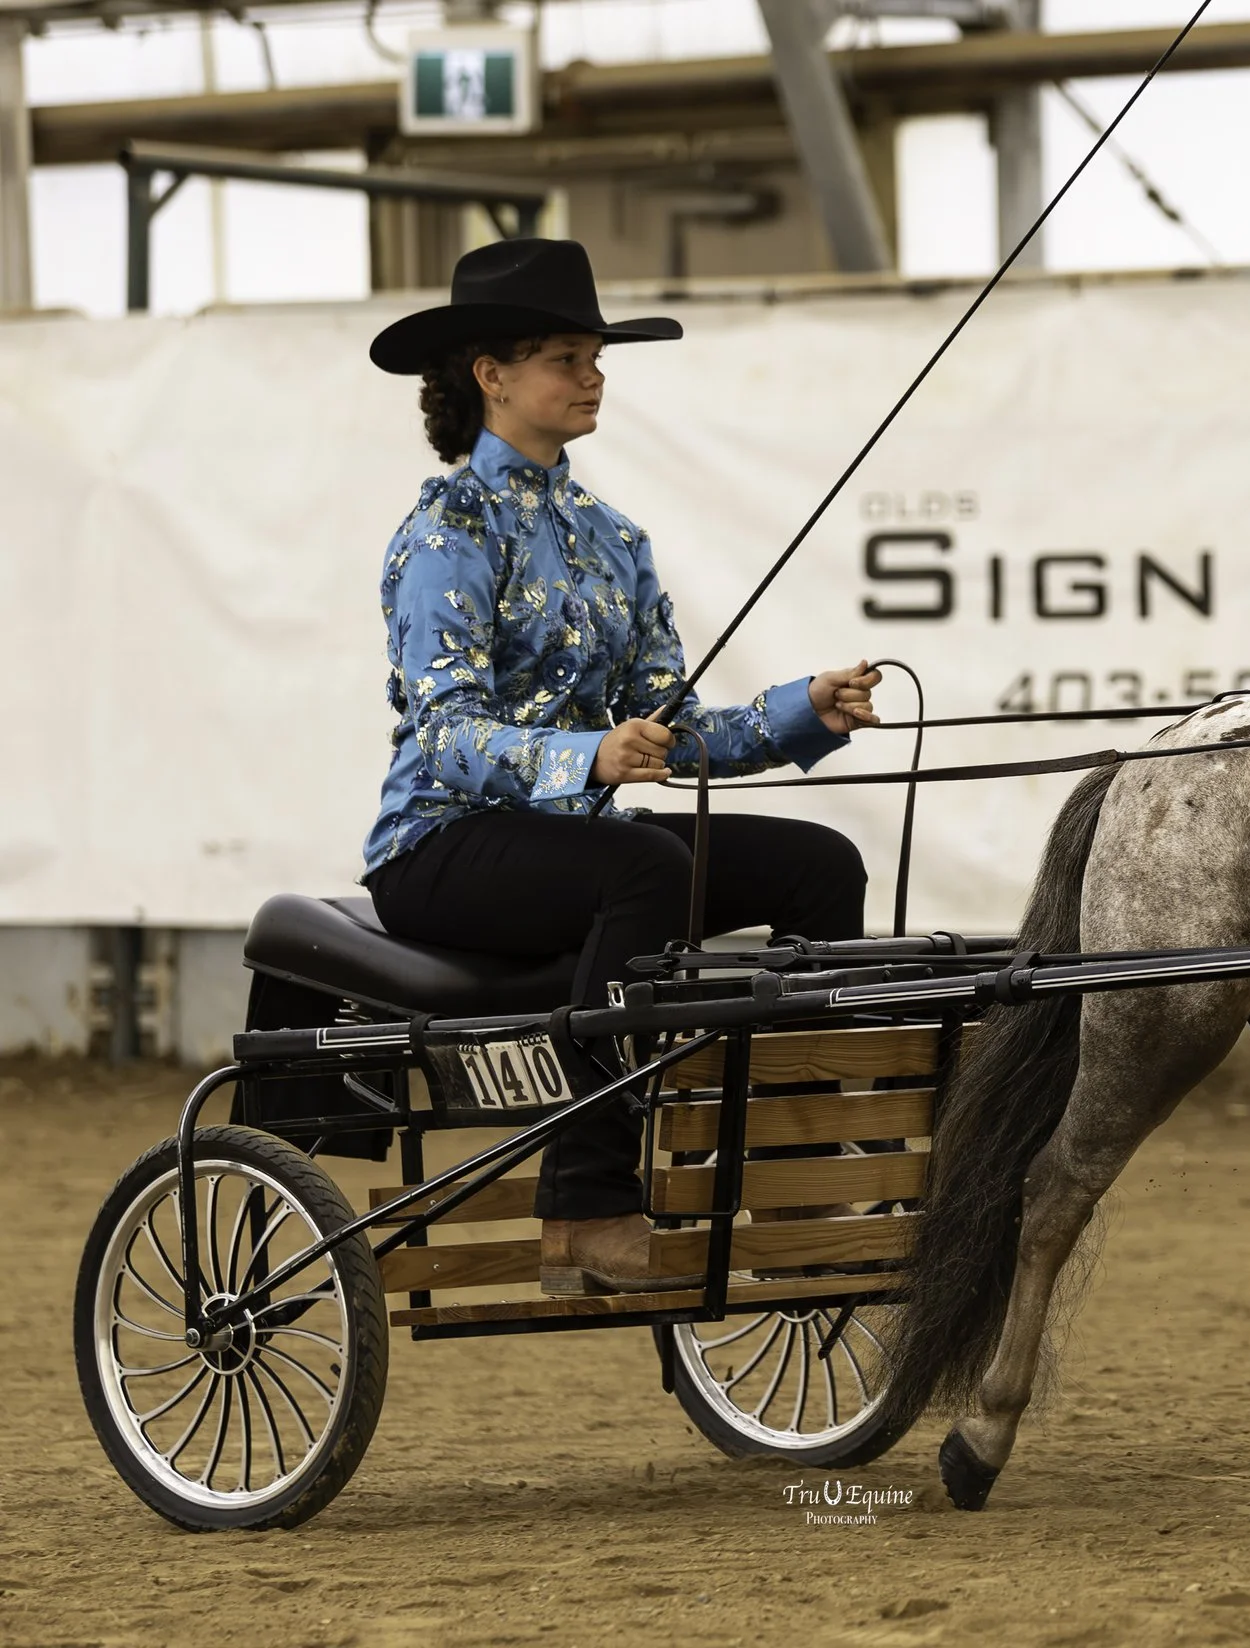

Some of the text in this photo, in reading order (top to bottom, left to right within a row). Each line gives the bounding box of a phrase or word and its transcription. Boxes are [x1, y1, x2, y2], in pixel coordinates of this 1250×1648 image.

[859, 490, 980, 522] OLDS
[862, 530, 1213, 621] SIGN
[464, 1045, 563, 1106] 140
